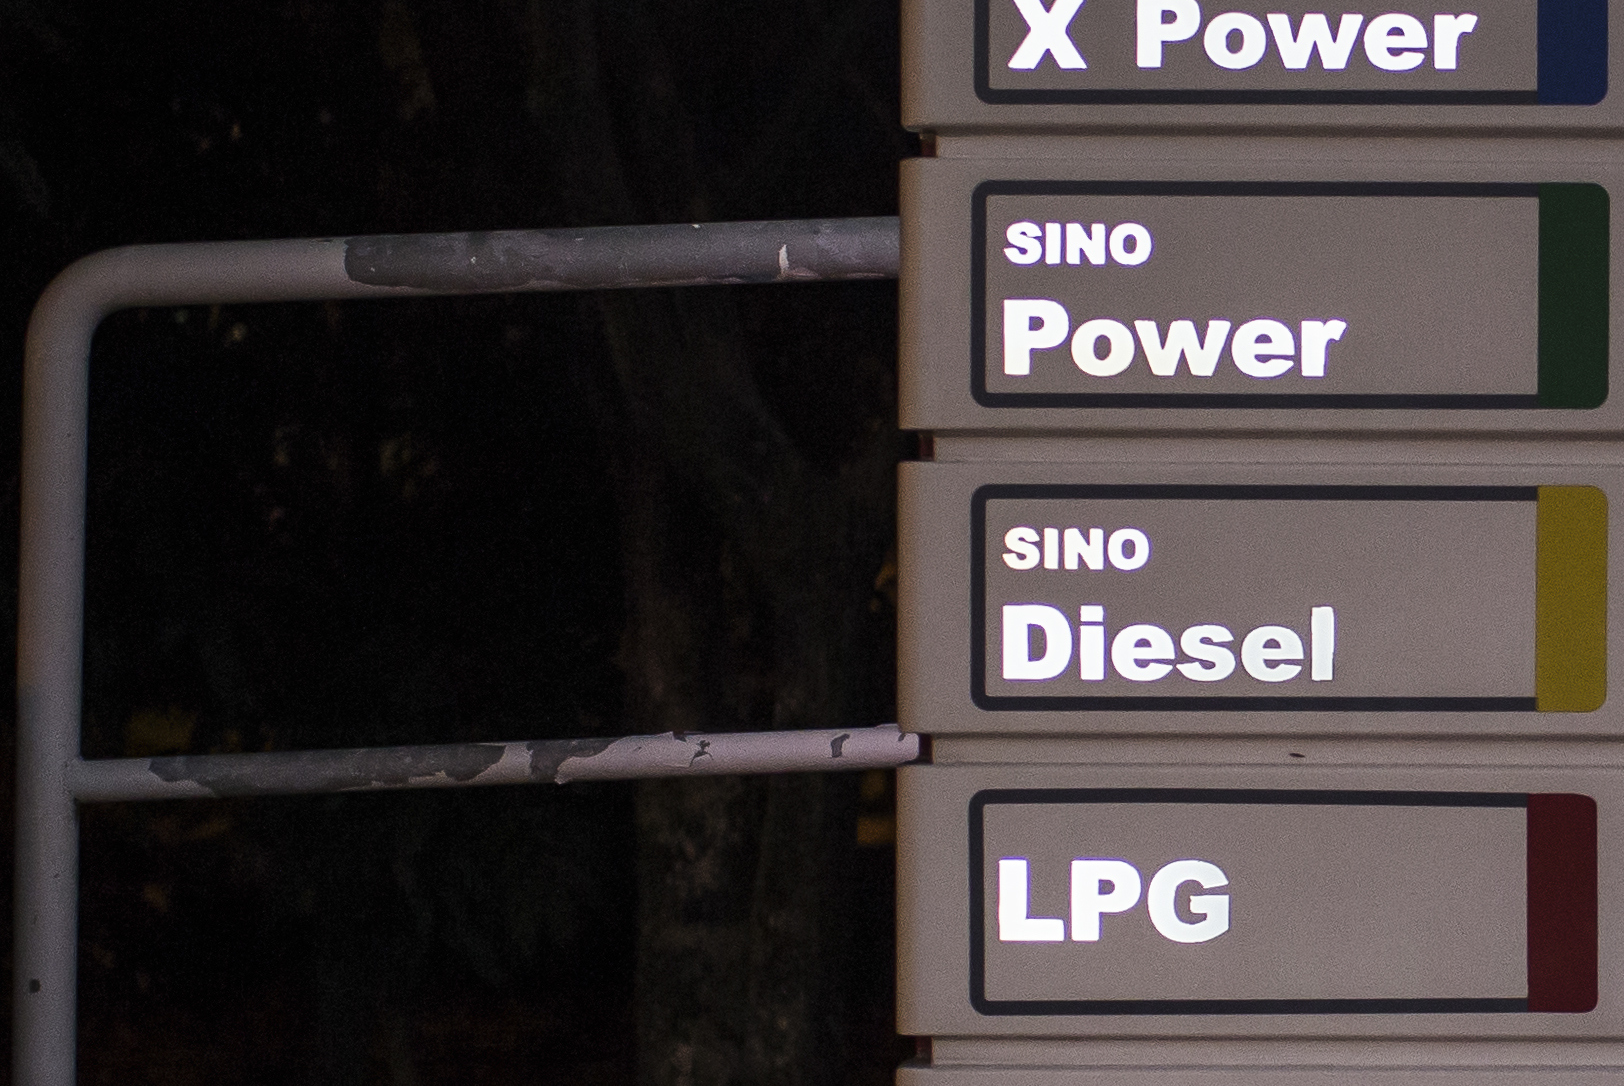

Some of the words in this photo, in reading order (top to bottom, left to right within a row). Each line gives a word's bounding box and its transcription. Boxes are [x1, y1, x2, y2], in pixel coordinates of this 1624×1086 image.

[1003, 221, 1153, 265] SINO
[1002, 299, 1347, 378] Power
[1002, 526, 1151, 570] SINO
[1001, 604, 1335, 682] Diesel
[998, 858, 1231, 944] LPG
